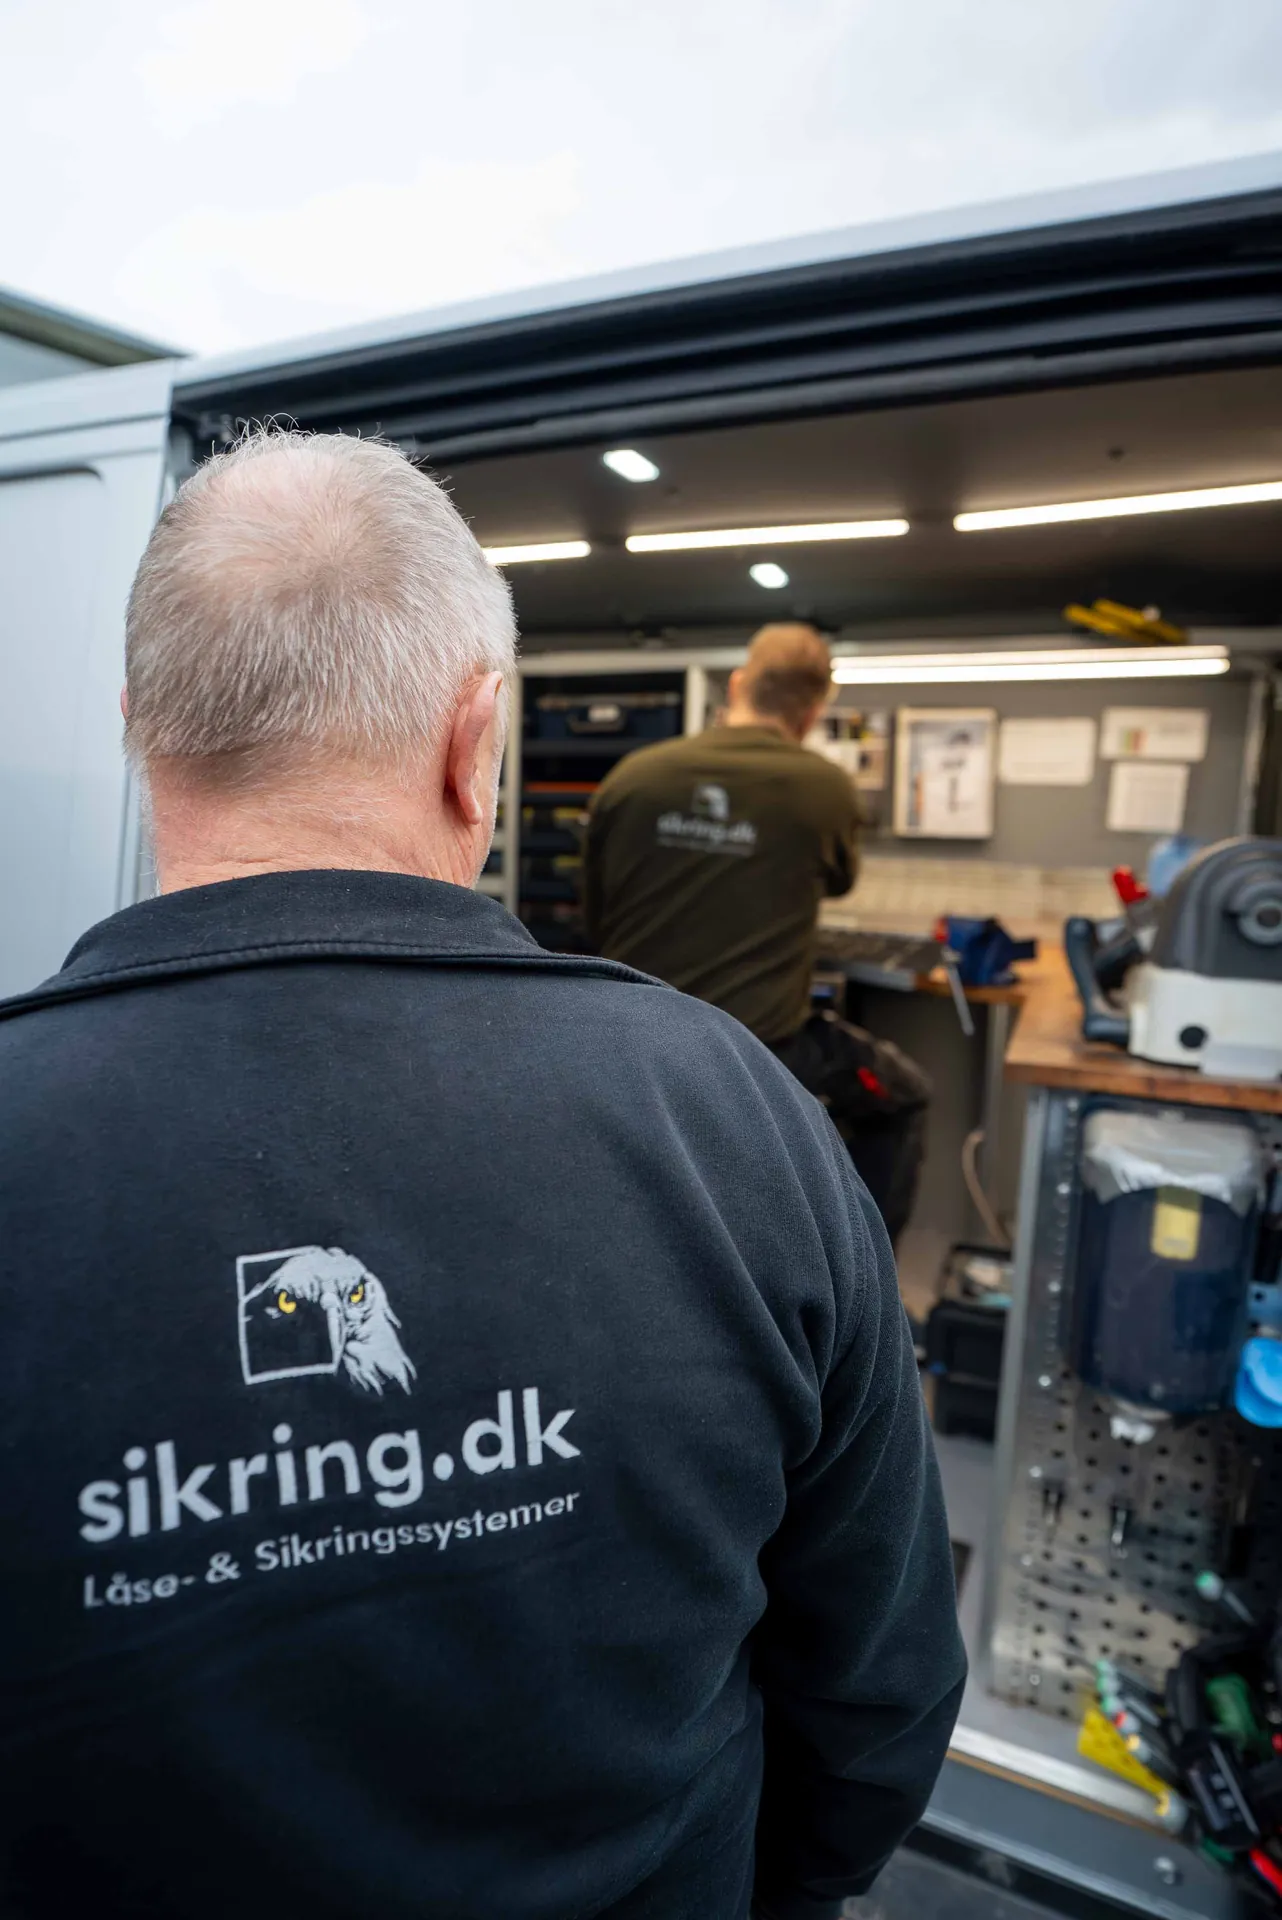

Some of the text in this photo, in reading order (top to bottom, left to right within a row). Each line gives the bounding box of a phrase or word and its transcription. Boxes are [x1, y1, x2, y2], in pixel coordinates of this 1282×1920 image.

[78, 1386, 583, 1544] sikring.dk
[84, 1491, 581, 1608] Låse- & Sikringssystemer
